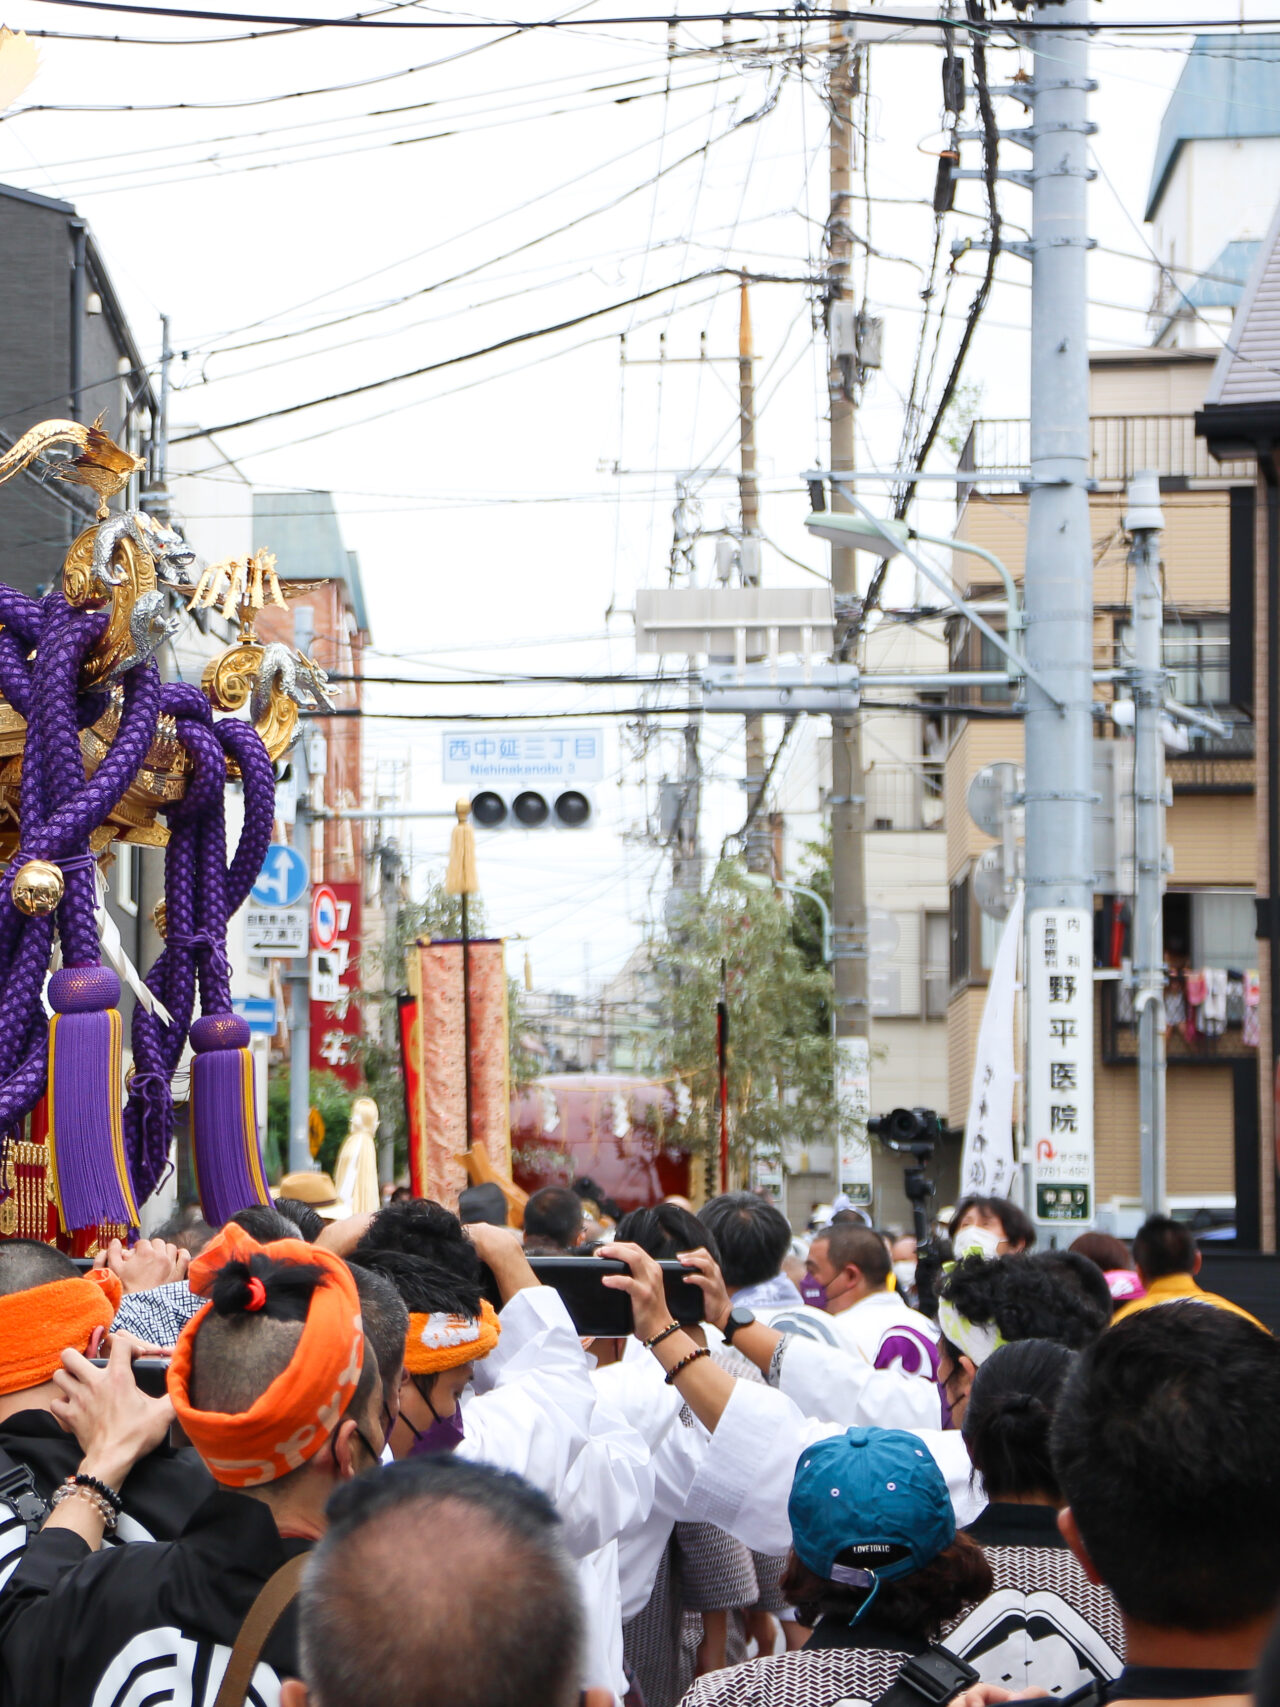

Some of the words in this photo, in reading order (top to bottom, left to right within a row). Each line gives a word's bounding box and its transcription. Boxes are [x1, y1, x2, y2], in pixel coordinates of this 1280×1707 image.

[449, 737, 596, 761] 西中延三丁目
[470, 763, 563, 776] Nishinakanobu
[1049, 975, 1079, 1134] 野平医院
[853, 1544, 890, 1553] LOVETOXIC
